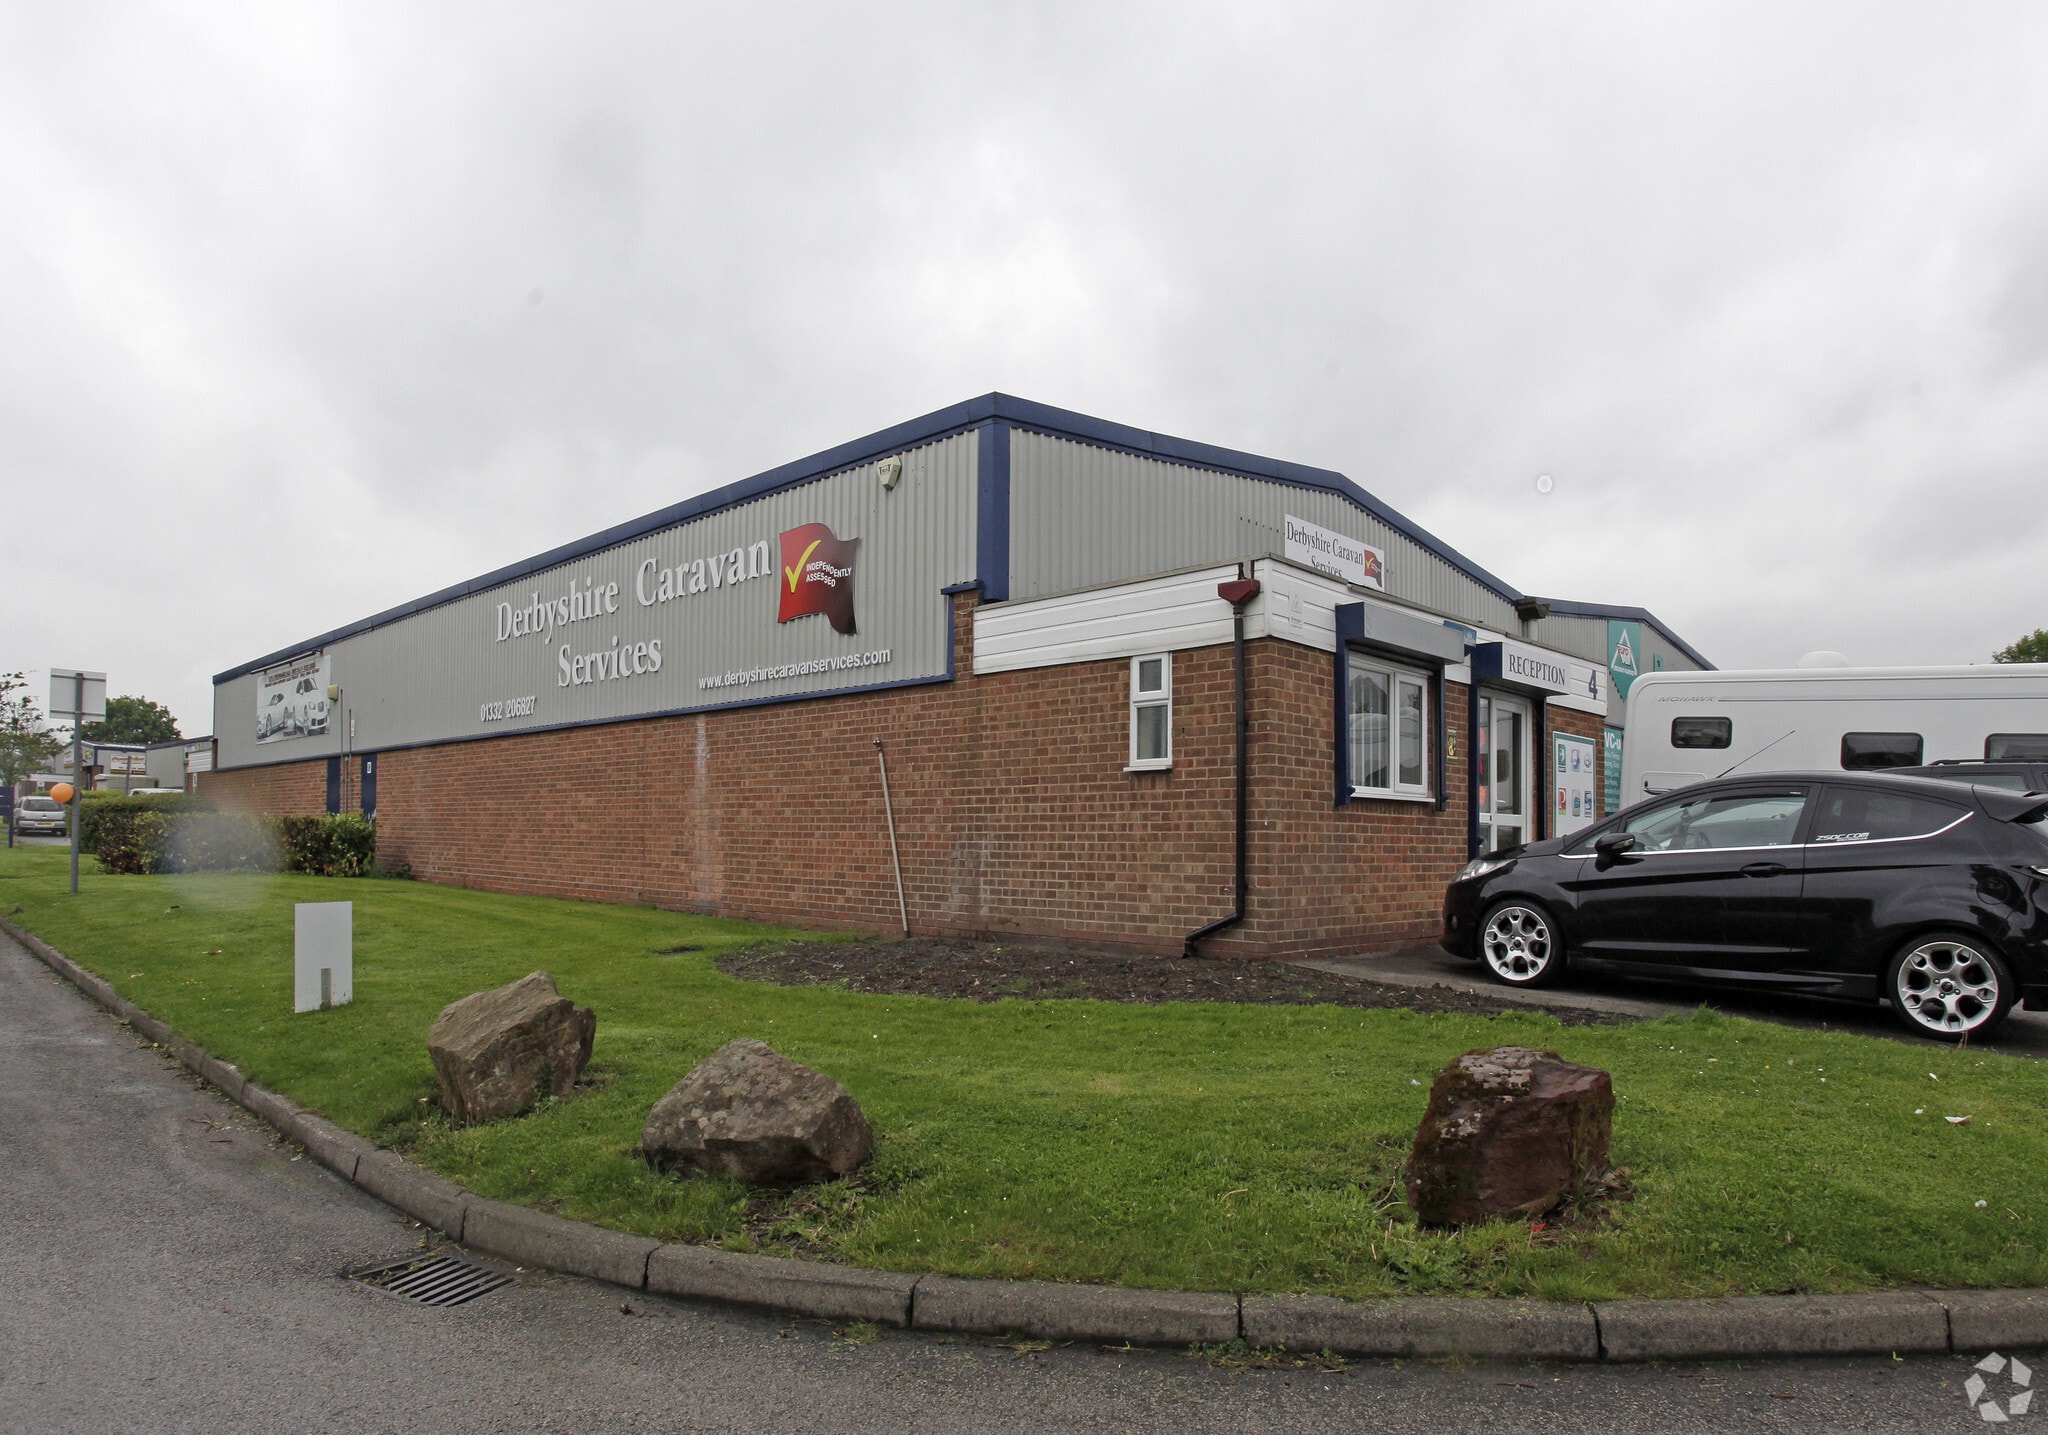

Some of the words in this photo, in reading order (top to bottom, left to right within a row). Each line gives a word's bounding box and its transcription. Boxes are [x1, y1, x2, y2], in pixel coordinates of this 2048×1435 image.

[1287, 521, 1331, 554] Derbyshire
[1332, 538, 1363, 565] Caravan
[805, 572, 836, 587] ASSESSED
[806, 561, 852, 578] INDEPENDENTLY
[496, 576, 619, 645] Derbyshire
[636, 540, 772, 607] Caravan
[558, 635, 662, 687] Services
[698, 649, 891, 689] www.derbyshirecaravanservices.com
[1509, 654, 1565, 686] RECEPTION
[1588, 669, 1598, 700] 4
[480, 702, 503, 722] 01332
[506, 695, 536, 718] 206827
